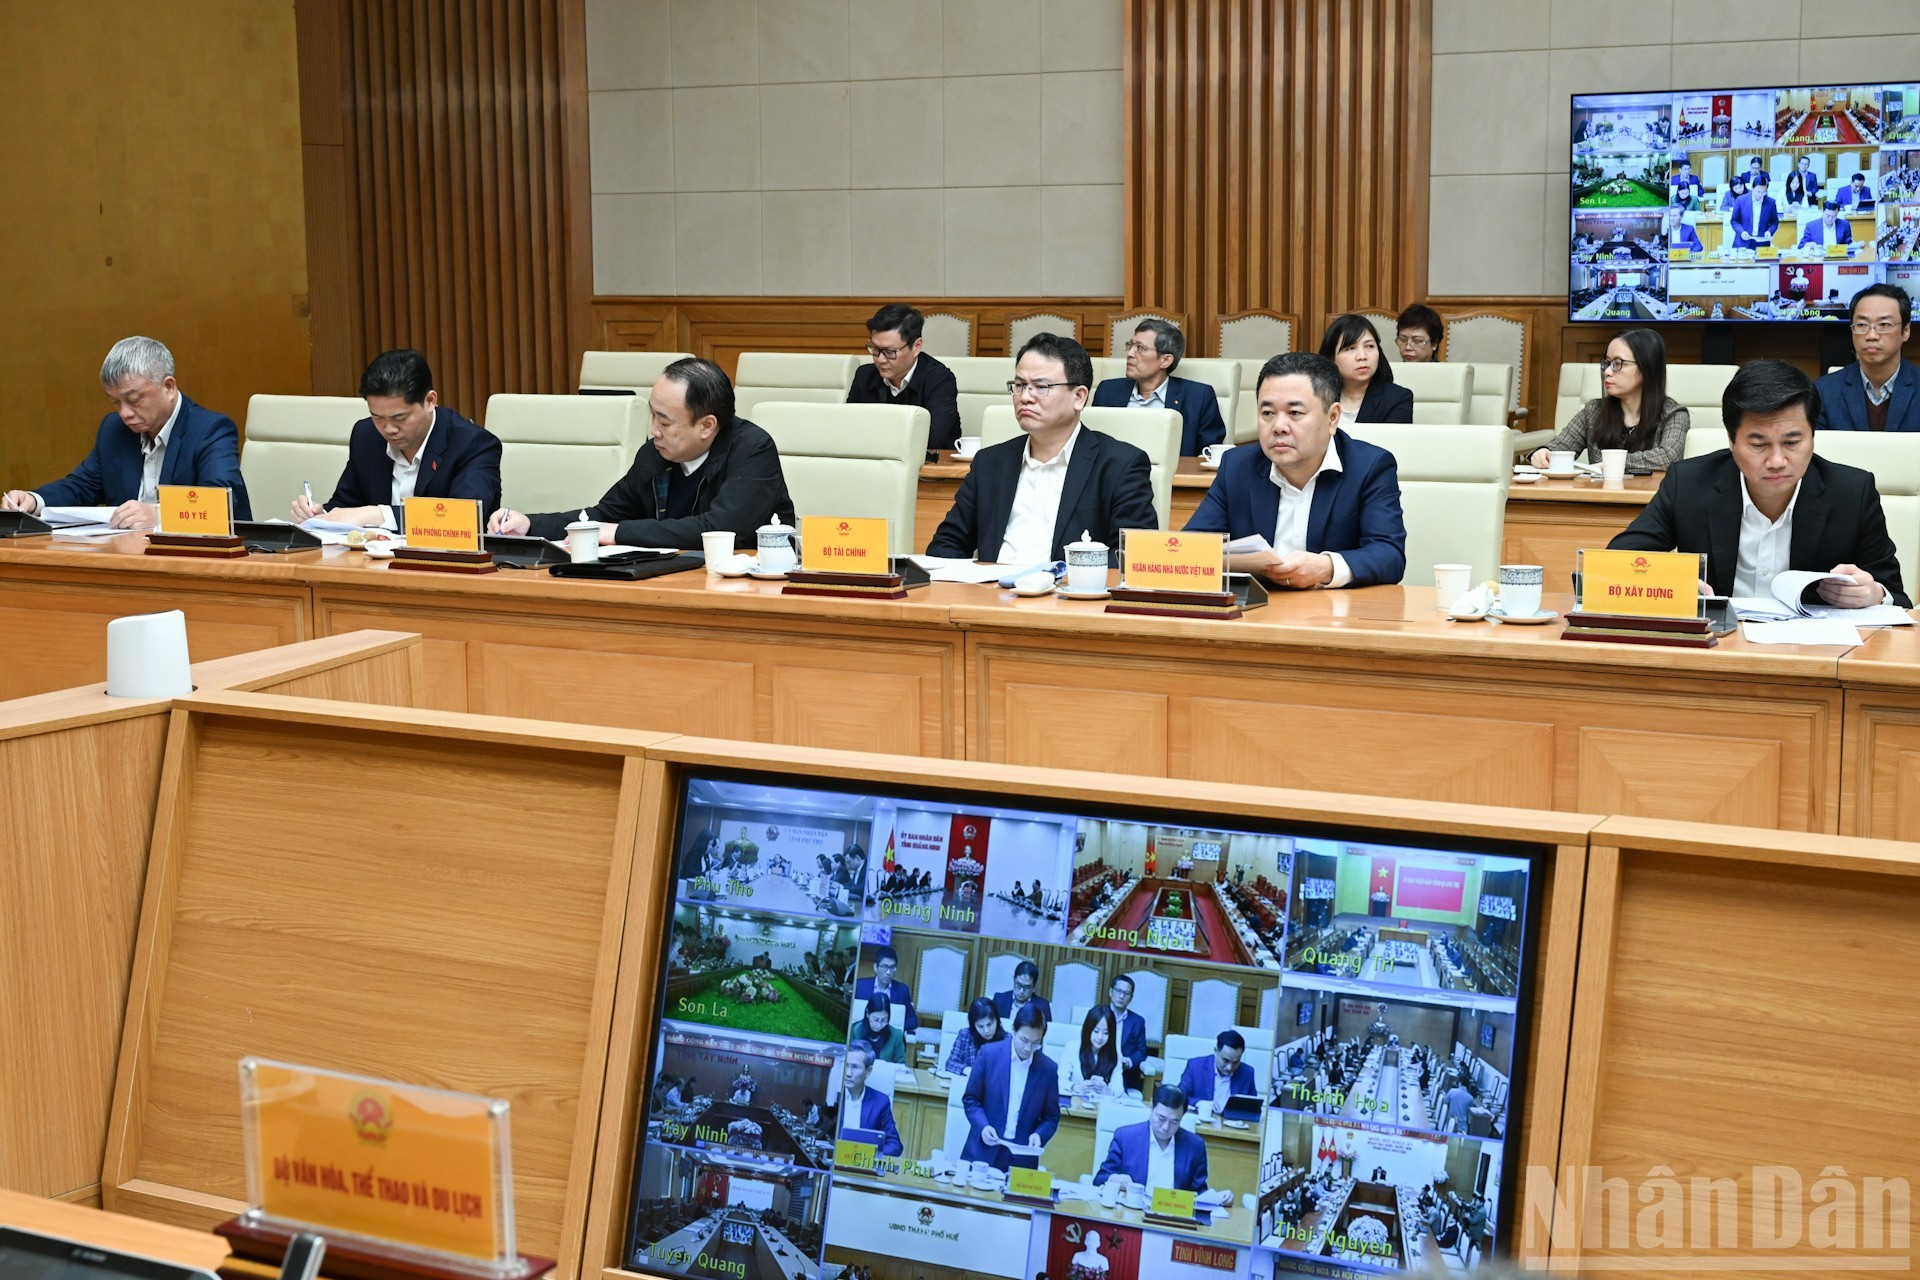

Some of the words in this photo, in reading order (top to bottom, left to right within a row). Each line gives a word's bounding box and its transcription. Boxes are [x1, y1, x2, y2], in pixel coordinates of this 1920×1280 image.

[1580, 197, 1595, 205] Son
[1605, 308, 1630, 317] Quang
[1690, 308, 1706, 316] Hue
[1800, 309, 1820, 317] Long
[179, 510, 189, 520] BỘ
[199, 510, 207, 520] TẾ
[411, 526, 422, 536] VĂN
[424, 527, 441, 537] PHÒNG
[443, 528, 459, 538] CHÍNH
[460, 528, 471, 538] PHỦ
[823, 546, 831, 558] BỘ
[834, 546, 844, 556] TÀI
[846, 546, 866, 557] CHÍNH
[1132, 562, 1146, 572] NGÂN
[1147, 562, 1161, 573] HÀNG
[1162, 563, 1173, 574] NHÀ
[1175, 564, 1188, 575] NƯỚC
[1190, 563, 1201, 577] VIỆT
[1202, 566, 1214, 576] NAM
[1609, 584, 1621, 598] BỘ
[1625, 585, 1643, 597] XÂY
[1646, 587, 1673, 600] DỰNG
[694, 876, 720, 893] Phu
[728, 878, 753, 897] Tho
[881, 898, 931, 923] Quang
[940, 904, 975, 923] Ninh
[1084, 922, 1138, 947] Quang
[1303, 946, 1362, 974] Quang
[1372, 955, 1395, 973] Tri
[679, 997, 705, 1014] Son
[712, 1002, 727, 1017] La
[1291, 1083, 1345, 1106] Thanh
[1354, 1093, 1389, 1112] Hoa
[665, 1119, 689, 1140] Tay
[695, 1124, 728, 1144] Ninh
[903, 1160, 932, 1178] Phu
[274, 1155, 290, 1187] BỘ
[293, 1158, 317, 1187] VĂN
[352, 1165, 374, 1198] THỂ
[378, 1177, 409, 1205] THAO
[412, 1180, 429, 1208] VÀ
[432, 1187, 449, 1212] DU
[453, 1190, 482, 1221] LỊCH
[889, 1222, 906, 1231] UBND
[1276, 1221, 1313, 1242] Thai
[1323, 1229, 1393, 1256] Nguyen
[649, 1242, 691, 1265] Tuyen
[698, 1252, 746, 1279] Quang
[1175, 1243, 1193, 1262] TỈNH
[1194, 1247, 1212, 1265] VĨNH
[1213, 1252, 1234, 1268] LONG
